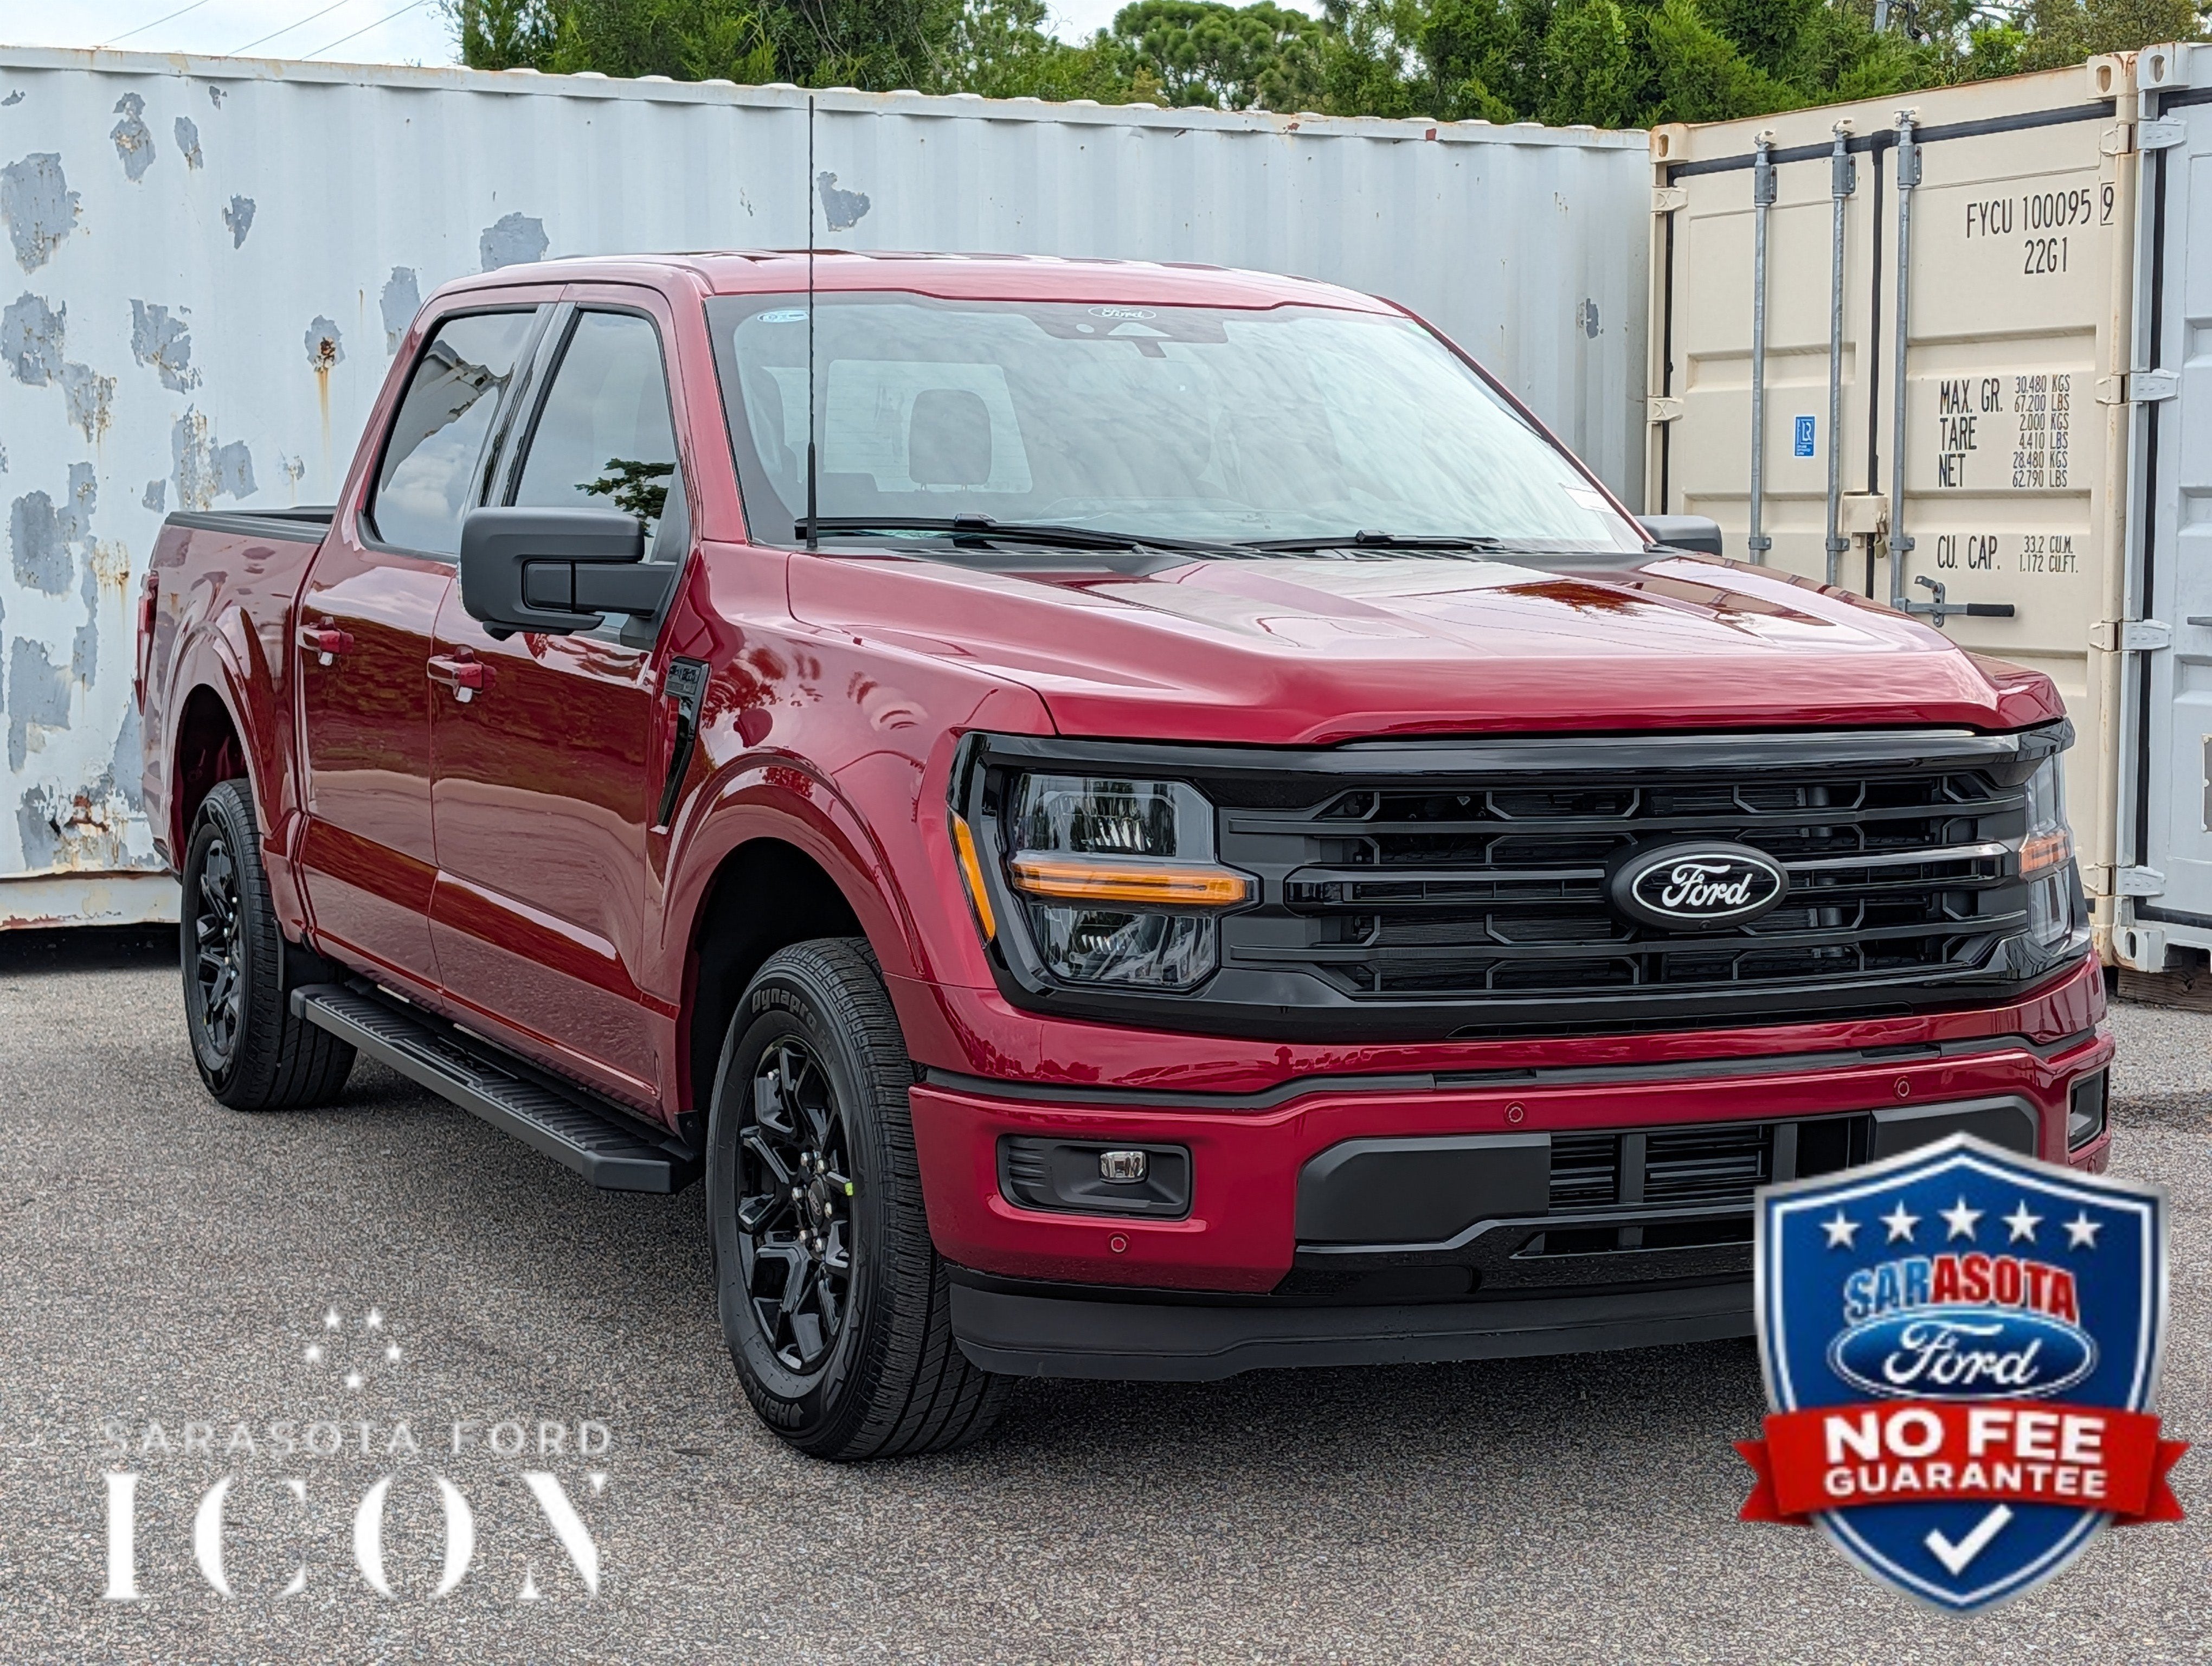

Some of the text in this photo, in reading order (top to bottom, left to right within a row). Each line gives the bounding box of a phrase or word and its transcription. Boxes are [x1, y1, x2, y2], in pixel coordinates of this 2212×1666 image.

[1966, 186, 2114, 239] FYCU 100095 9
[2024, 236, 2068, 274] 22G1
[1939, 379, 1973, 415] MAX.
[1981, 378, 2003, 413] GR.
[2052, 374, 2070, 392] KGS
[2051, 393, 2070, 412] LBS
[1939, 416, 1977, 451] TARE
[2050, 412, 2069, 431] KGS
[2050, 431, 2068, 450] LBS
[1939, 453, 1966, 488] NET
[2049, 451, 2068, 469] KGS
[2049, 469, 2068, 488] LBS
[1937, 535, 1958, 569] CU.
[1967, 535, 2001, 570] CAP.
[1661, 863, 1753, 907] Ford
